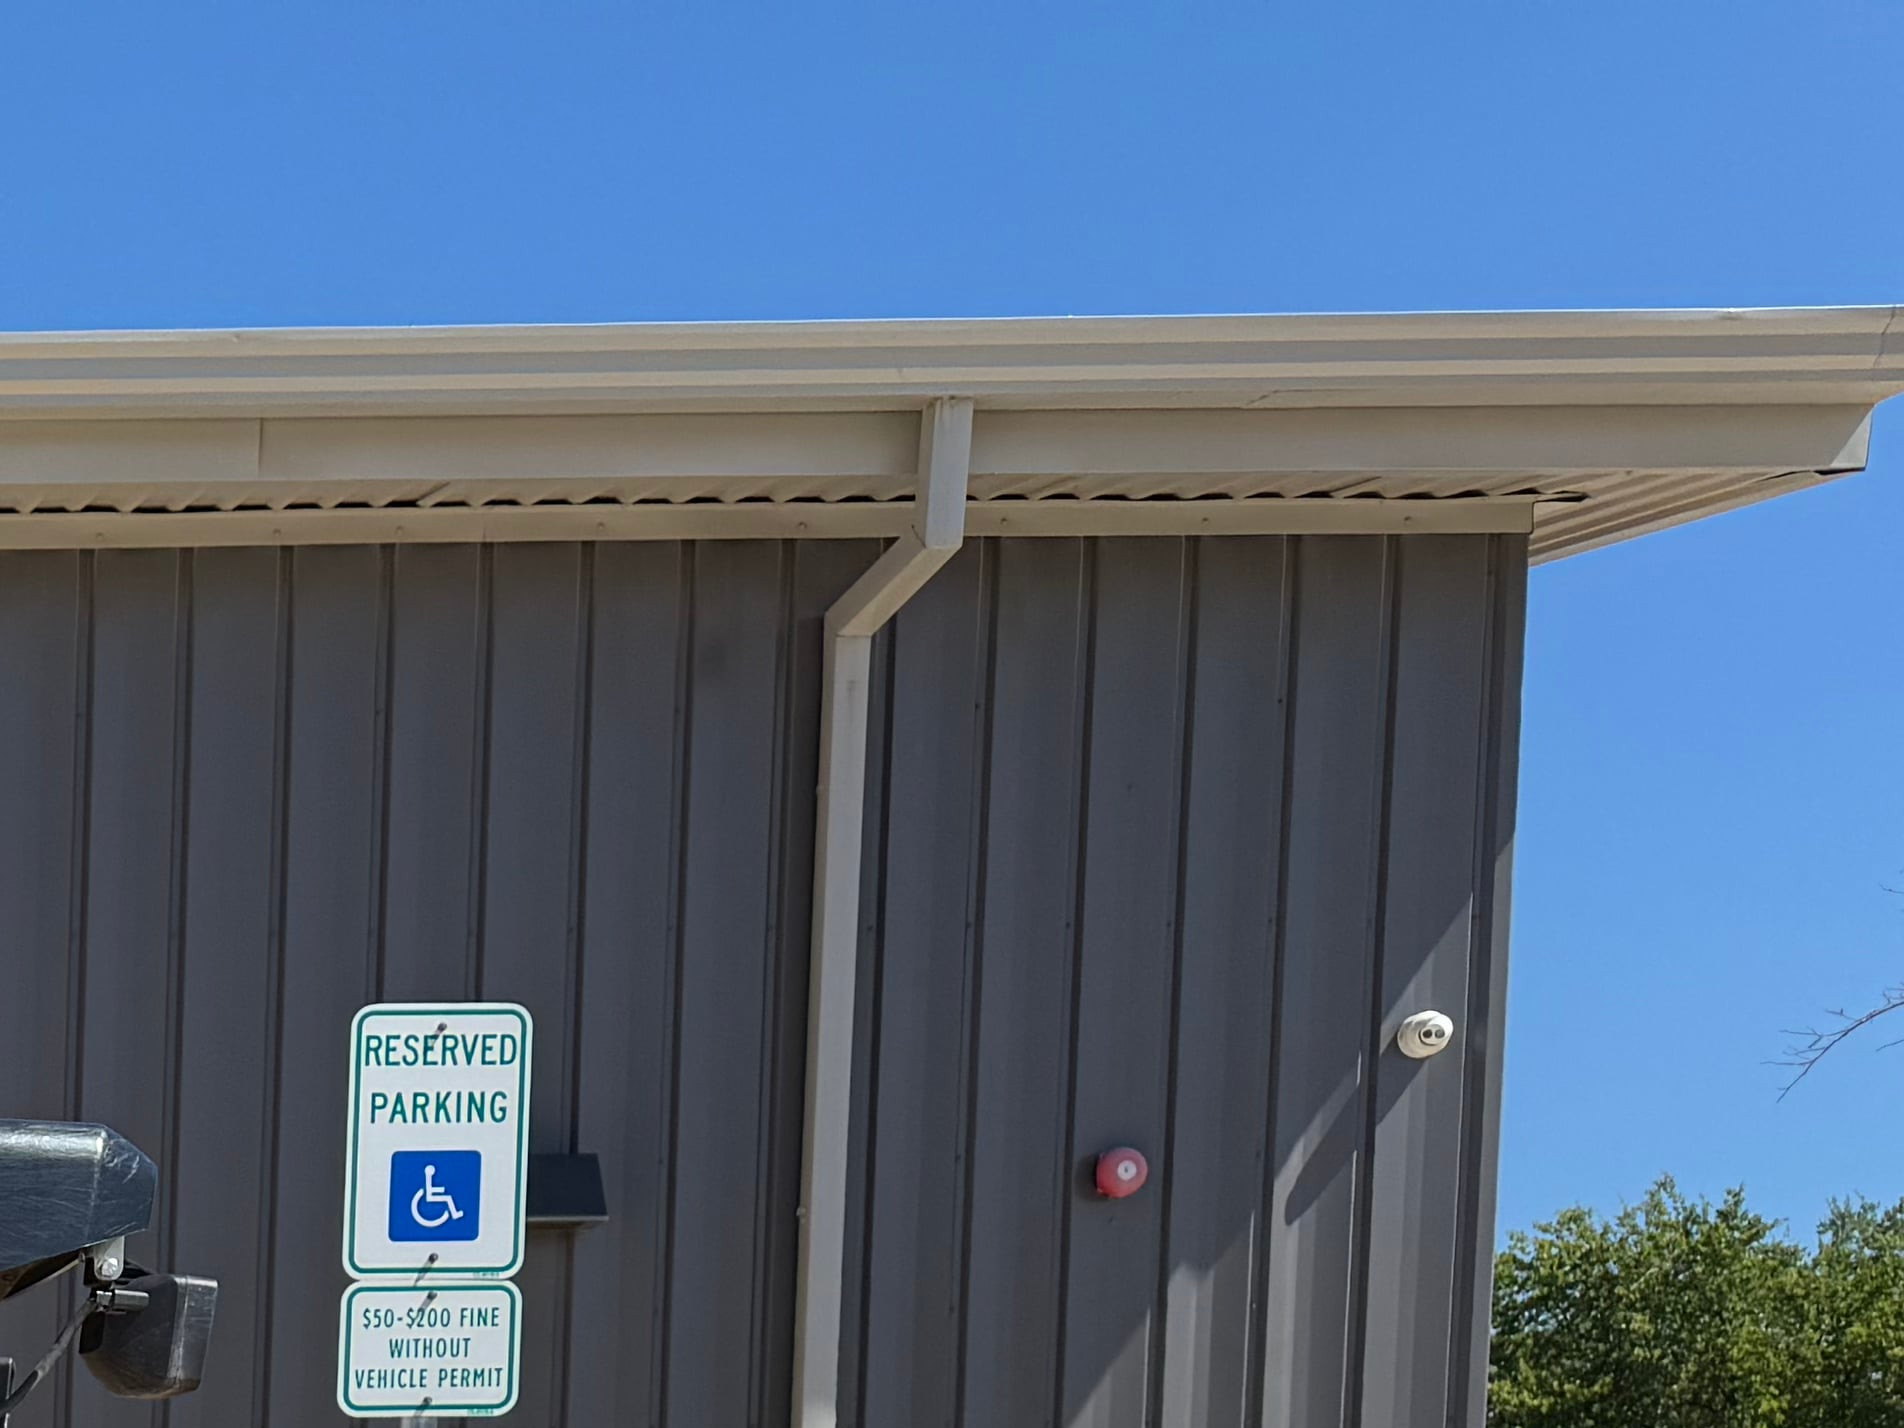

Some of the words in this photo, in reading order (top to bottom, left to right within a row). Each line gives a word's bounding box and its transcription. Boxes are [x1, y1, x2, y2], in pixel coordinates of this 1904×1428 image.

[364, 1033, 517, 1067] RESERVED
[370, 1091, 508, 1124] PARKING
[362, 1307, 451, 1330] $50-$200
[460, 1307, 500, 1327] FINE
[389, 1338, 471, 1358] WITHOUT
[355, 1369, 428, 1389] VEHICLE
[438, 1368, 504, 1388] PERMIT
